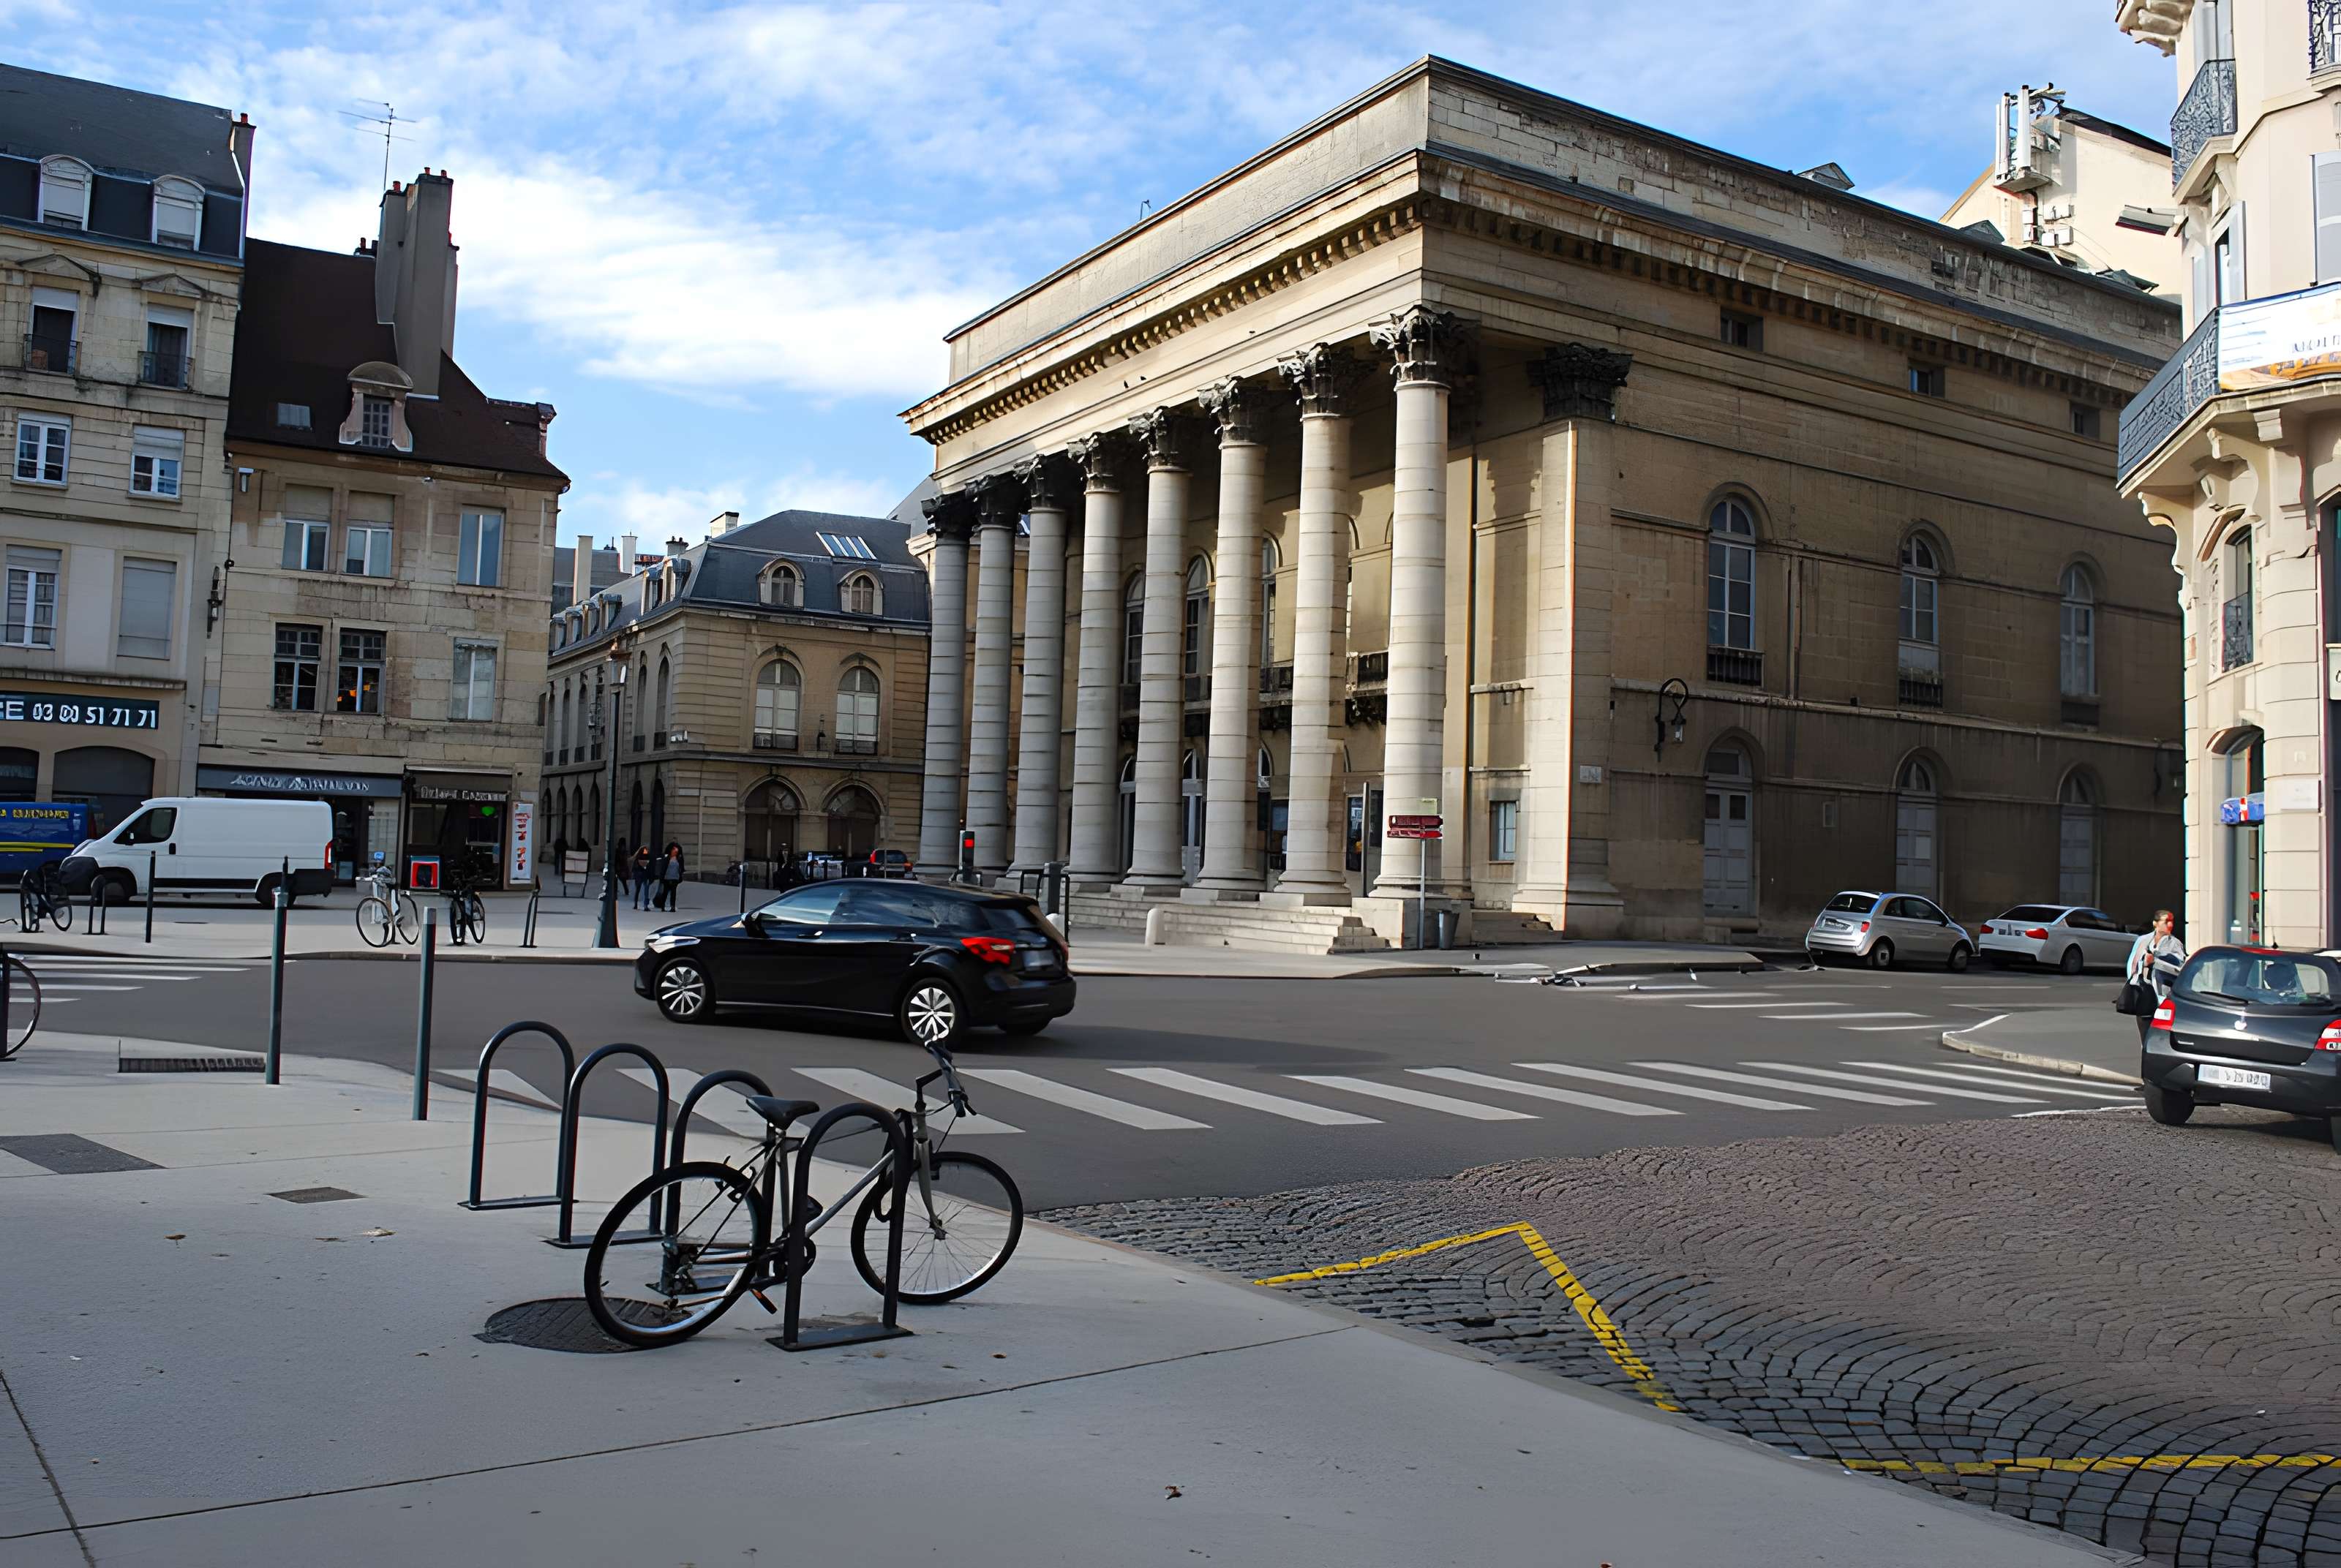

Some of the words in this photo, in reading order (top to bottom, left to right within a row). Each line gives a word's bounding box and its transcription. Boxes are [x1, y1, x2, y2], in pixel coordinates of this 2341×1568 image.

[86, 706, 105, 725] 51
[110, 708, 130, 726] 71
[138, 709, 156, 728] 71
